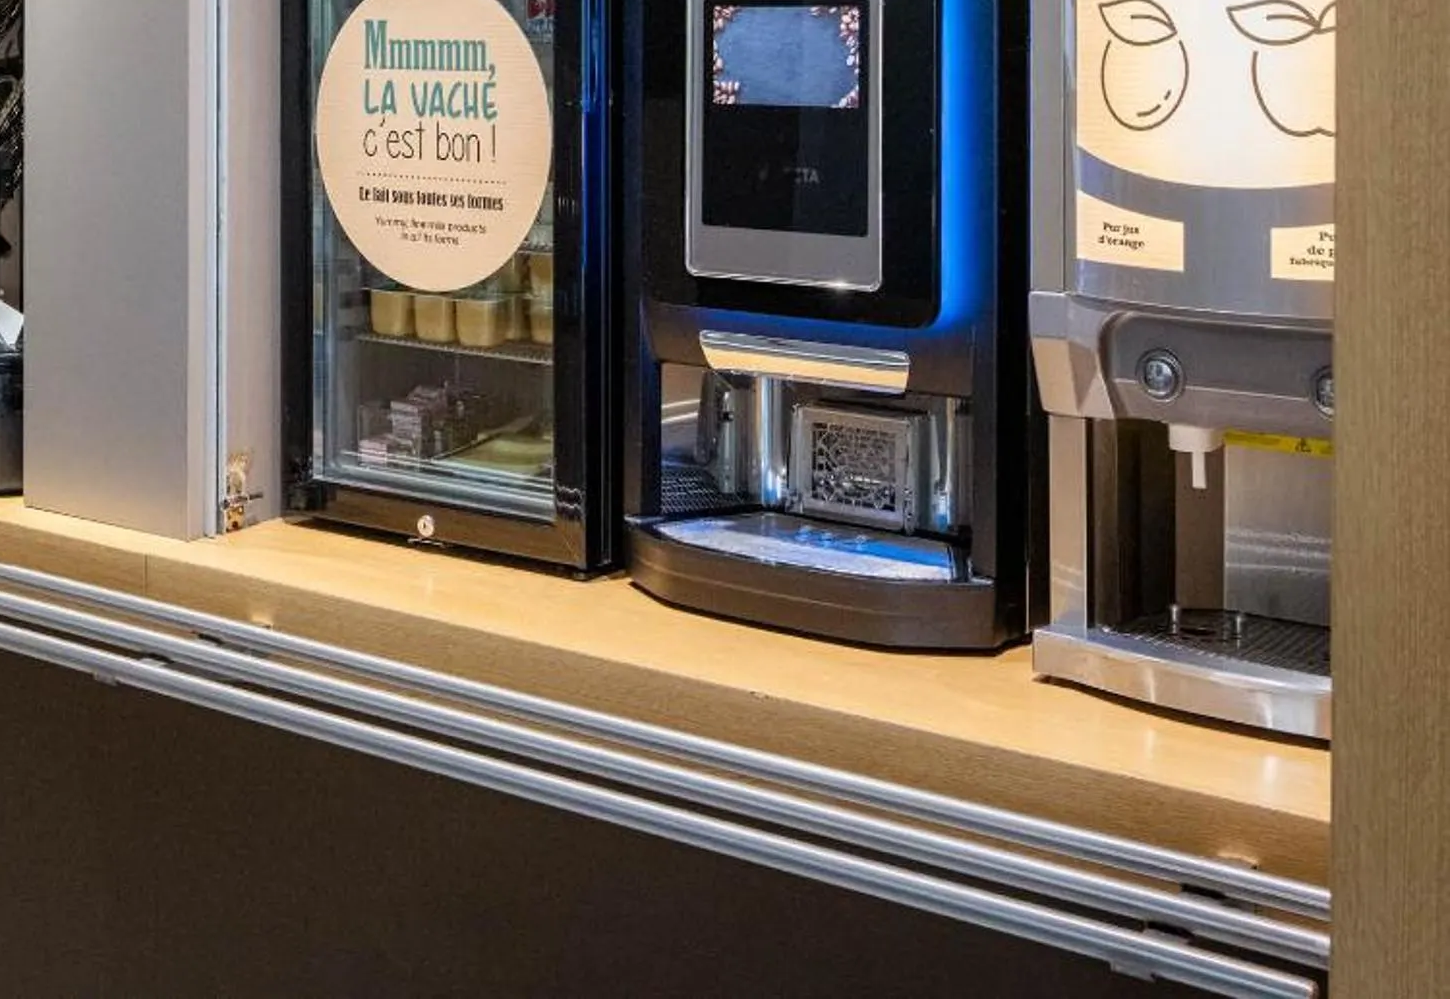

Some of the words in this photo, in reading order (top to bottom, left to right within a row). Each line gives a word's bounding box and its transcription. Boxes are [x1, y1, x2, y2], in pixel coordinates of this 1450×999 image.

[364, 19, 496, 81] Mmmmm,
[365, 78, 397, 115] LA
[410, 80, 499, 121] VACHE
[363, 115, 426, 160] c'est
[436, 120, 481, 163] bon
[1103, 221, 1121, 233] Pur
